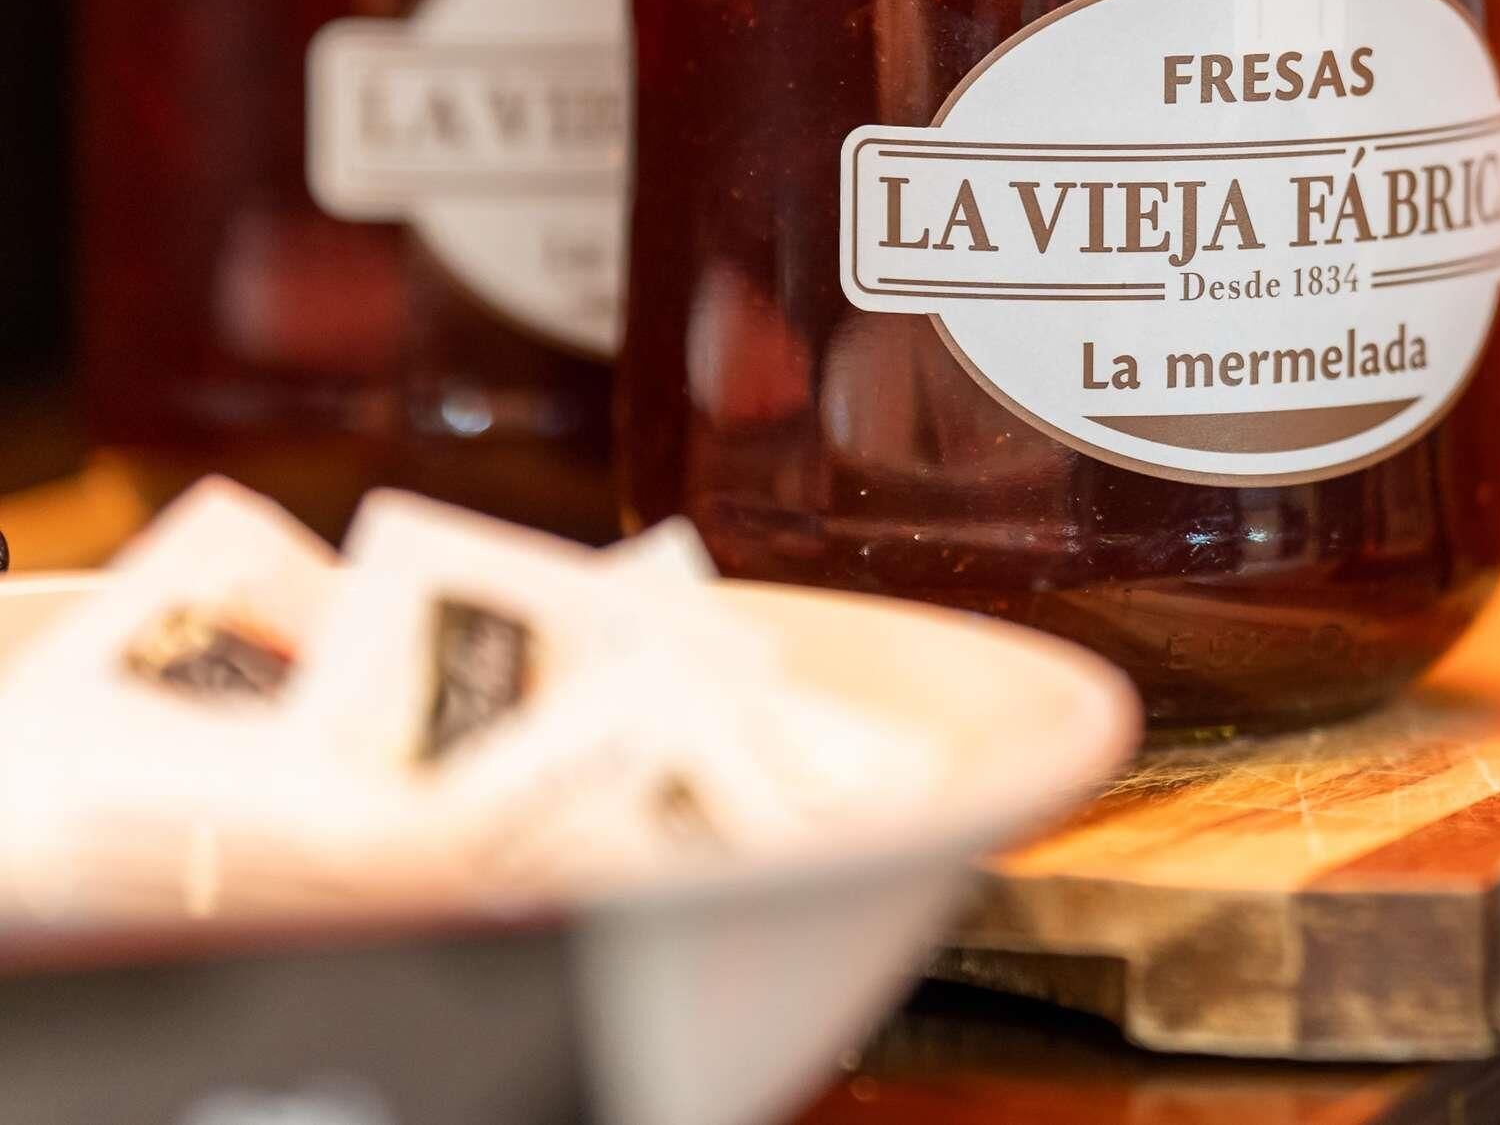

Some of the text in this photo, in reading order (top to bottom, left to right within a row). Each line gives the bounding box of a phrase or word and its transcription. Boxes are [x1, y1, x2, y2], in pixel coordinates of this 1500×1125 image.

[1162, 46, 1377, 105] FRESAS
[877, 176, 999, 252] LA
[1009, 178, 1266, 267] VIEJA
[1178, 264, 1360, 303] Desde 1834
[1082, 323, 1428, 391] La mermelada
